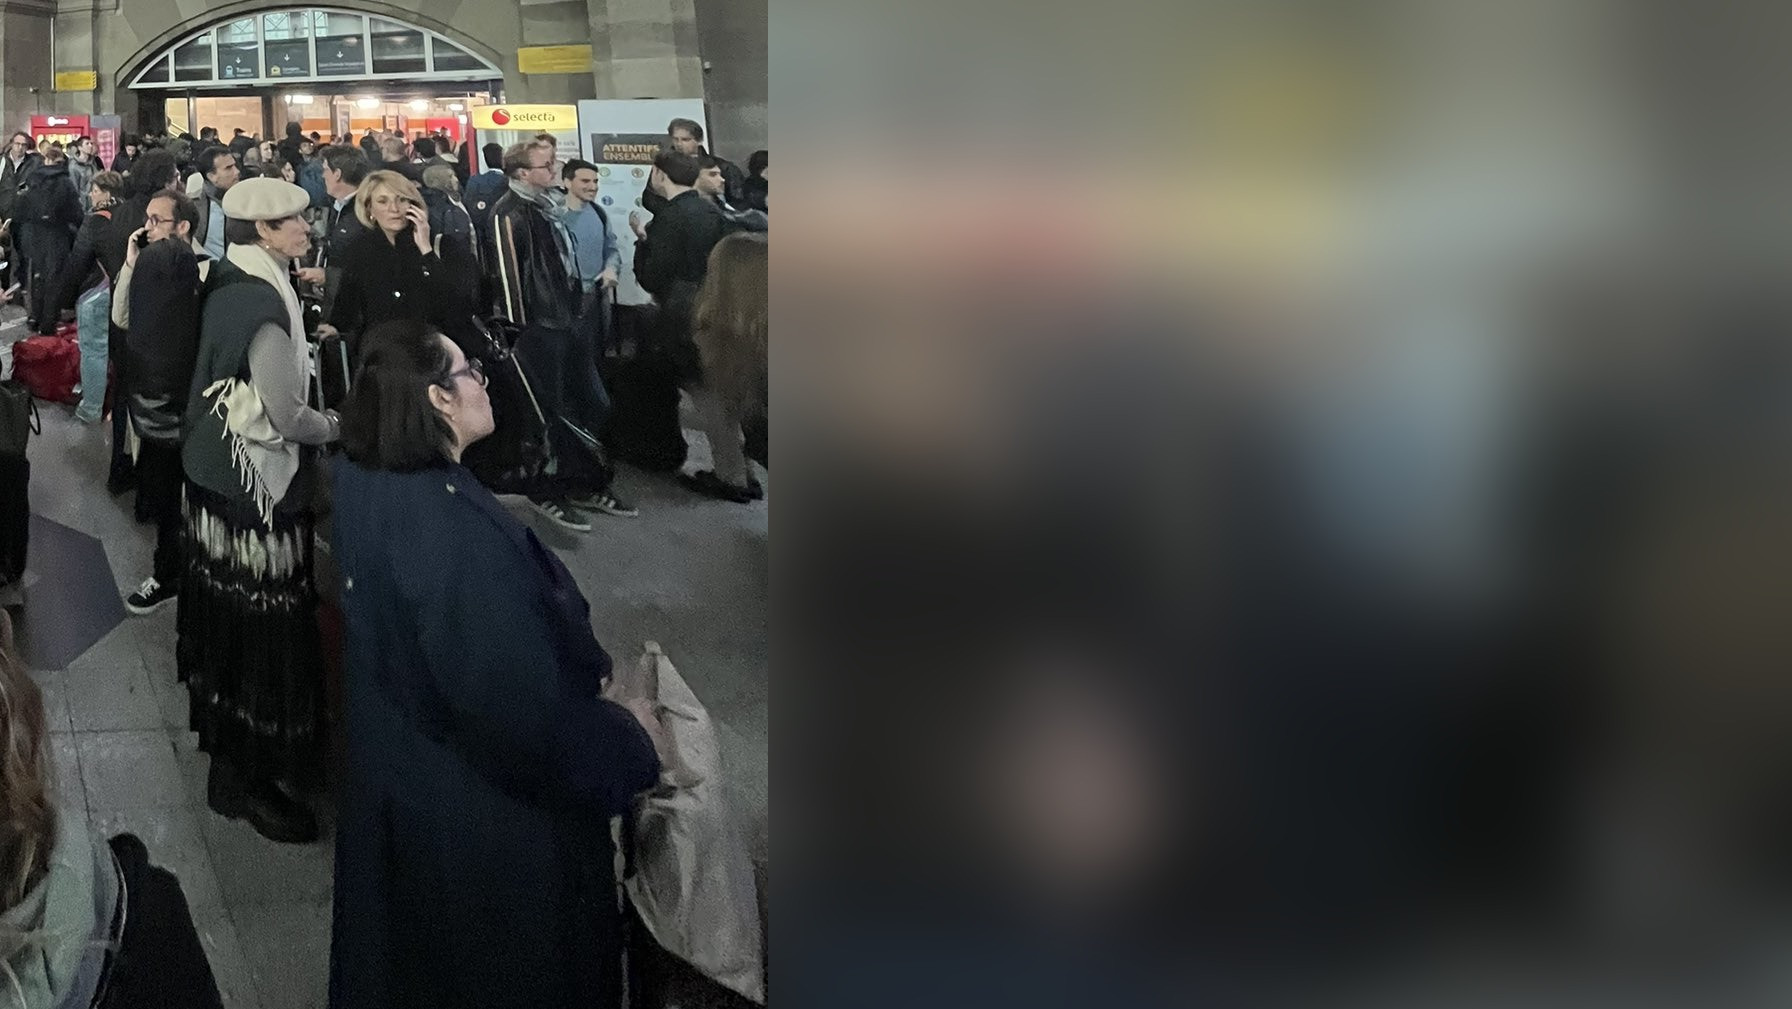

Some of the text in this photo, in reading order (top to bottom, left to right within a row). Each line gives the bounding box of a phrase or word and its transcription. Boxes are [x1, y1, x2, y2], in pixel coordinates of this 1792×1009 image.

[513, 112, 555, 122] selecta
[603, 144, 660, 153] ATTENTIFS
[603, 152, 653, 161] ENSEMBL
